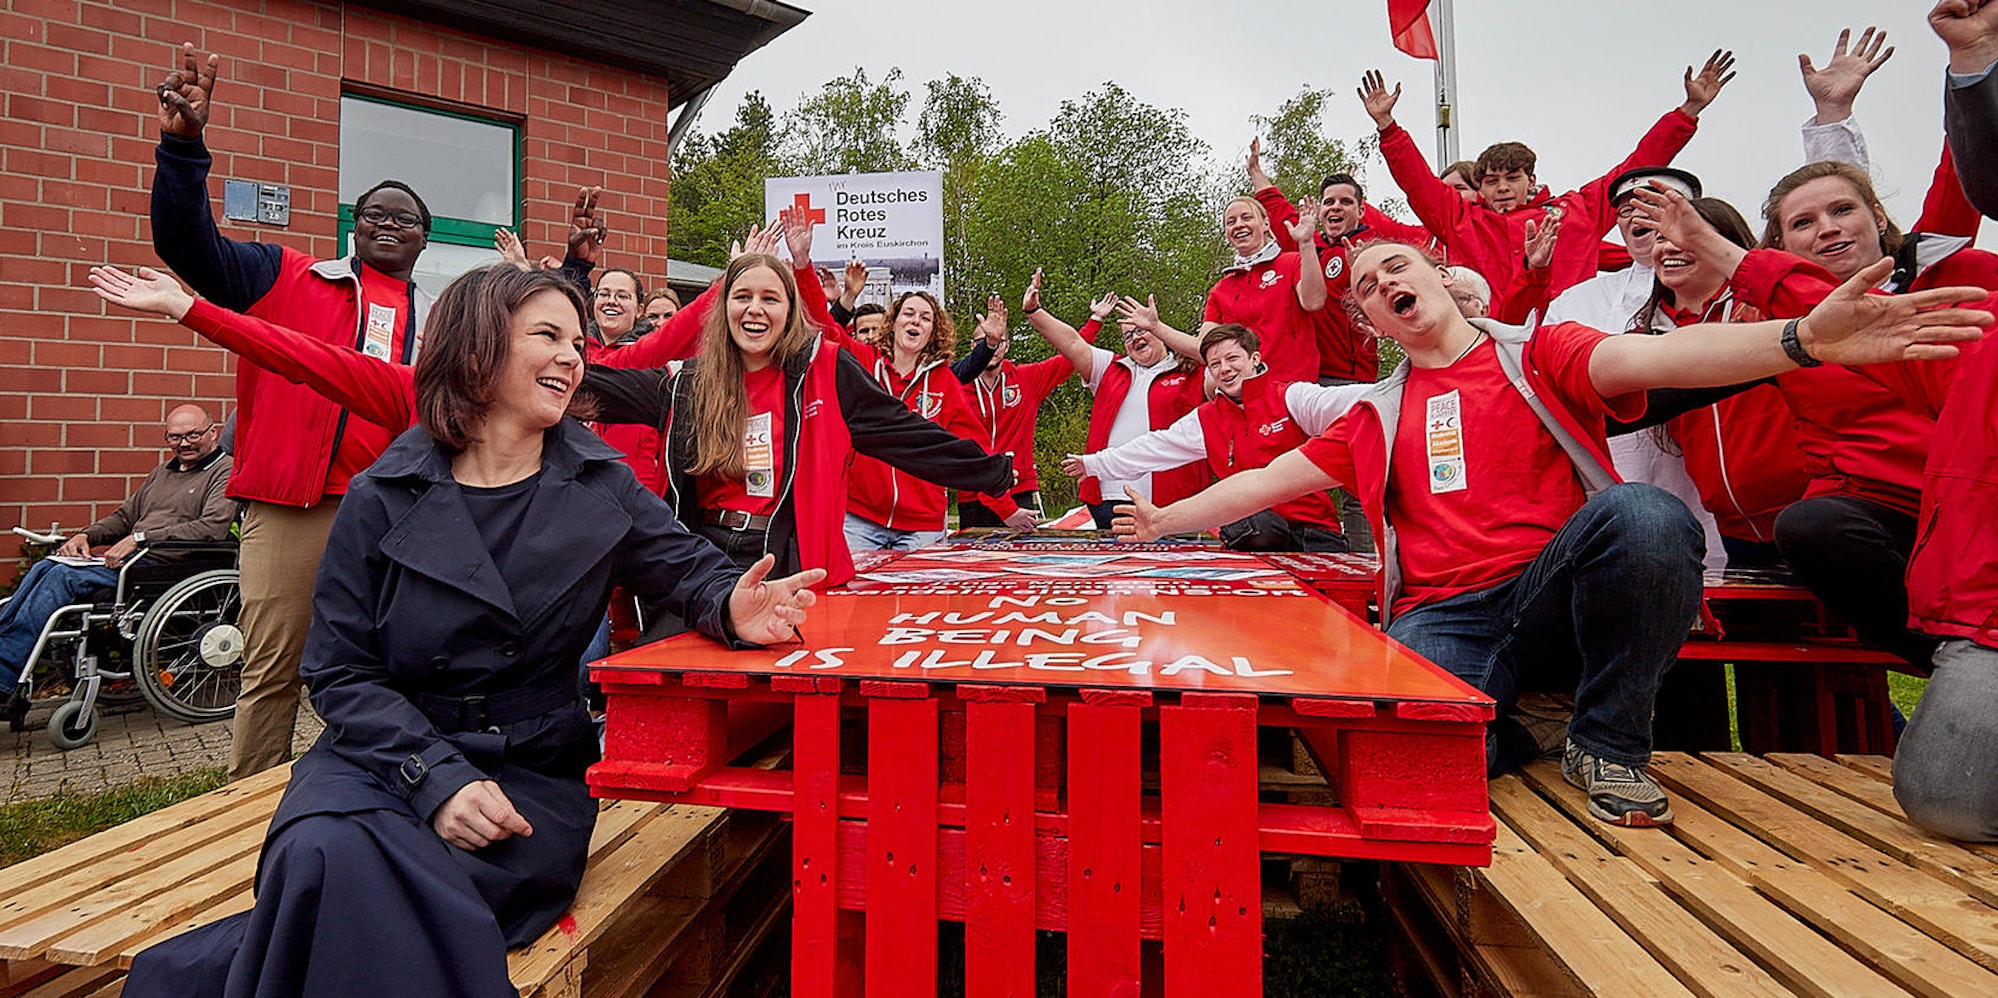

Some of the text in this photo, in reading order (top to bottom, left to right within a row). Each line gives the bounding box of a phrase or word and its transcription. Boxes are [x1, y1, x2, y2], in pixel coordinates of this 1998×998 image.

[837, 188, 928, 206] Deutsches
[837, 208, 886, 223] Rotes
[837, 226, 887, 240] Kreuz
[850, 241, 875, 249] Kreis
[876, 240, 929, 248] Euskirchen
[987, 595, 1089, 608] NO
[887, 611, 1176, 626] HUMAN
[877, 627, 1143, 648] BEING
[774, 648, 1294, 677] IS ILLEGAL
